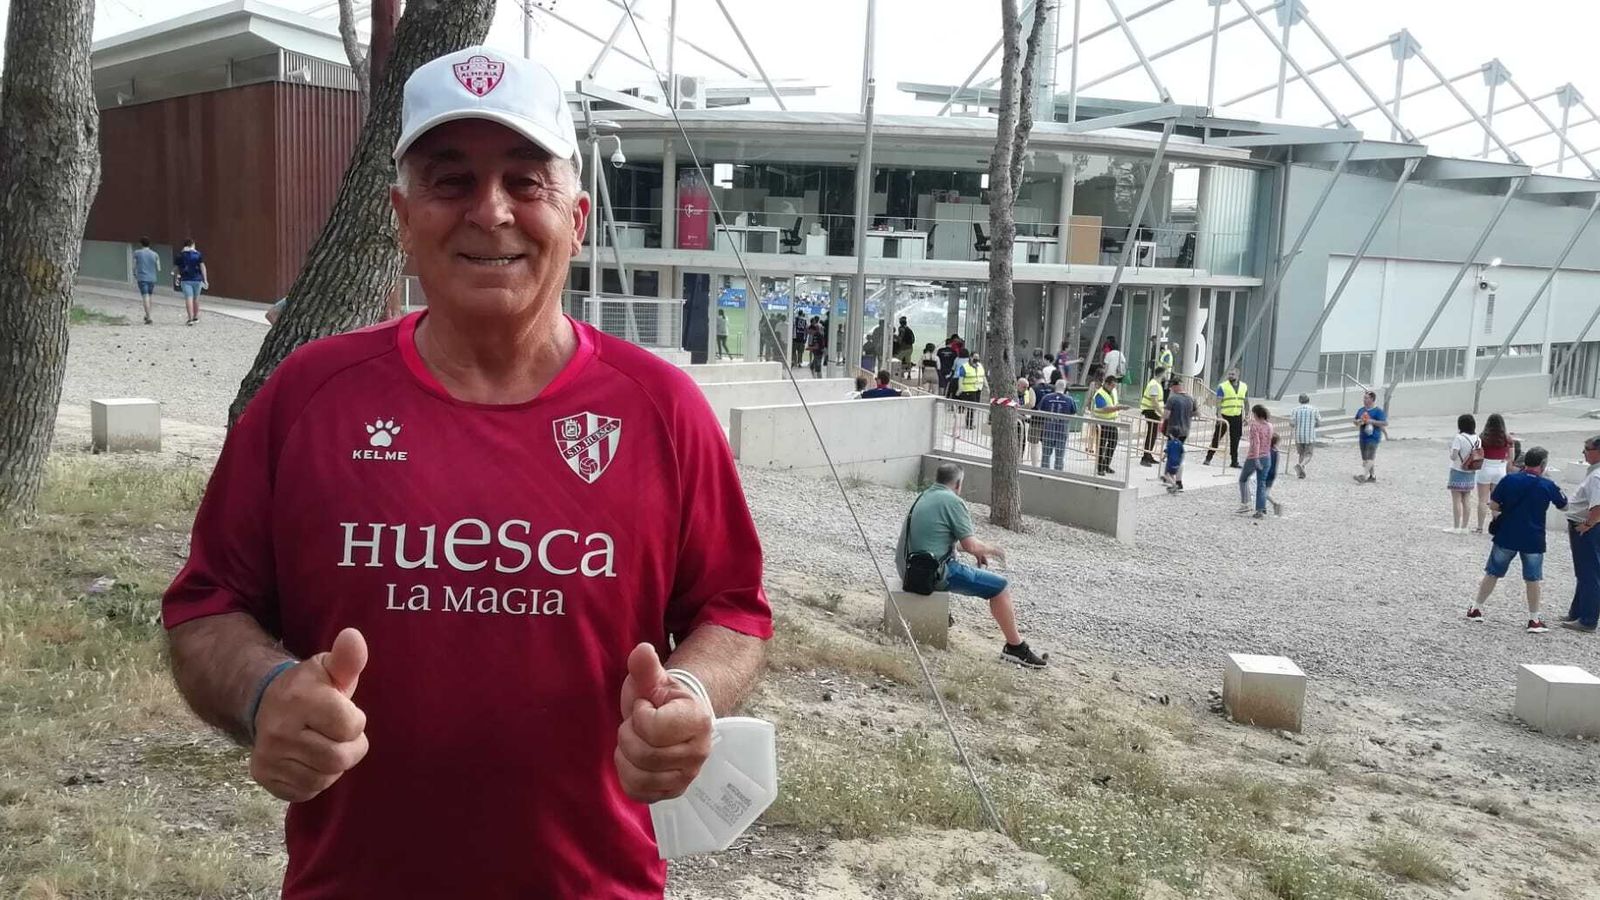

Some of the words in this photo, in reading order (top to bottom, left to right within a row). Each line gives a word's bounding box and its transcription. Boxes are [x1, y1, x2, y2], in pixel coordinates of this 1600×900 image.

[583, 423, 617, 446] HUESCA
[352, 449, 408, 461] KELME
[337, 518, 617, 578] Huesca
[386, 583, 431, 611] La
